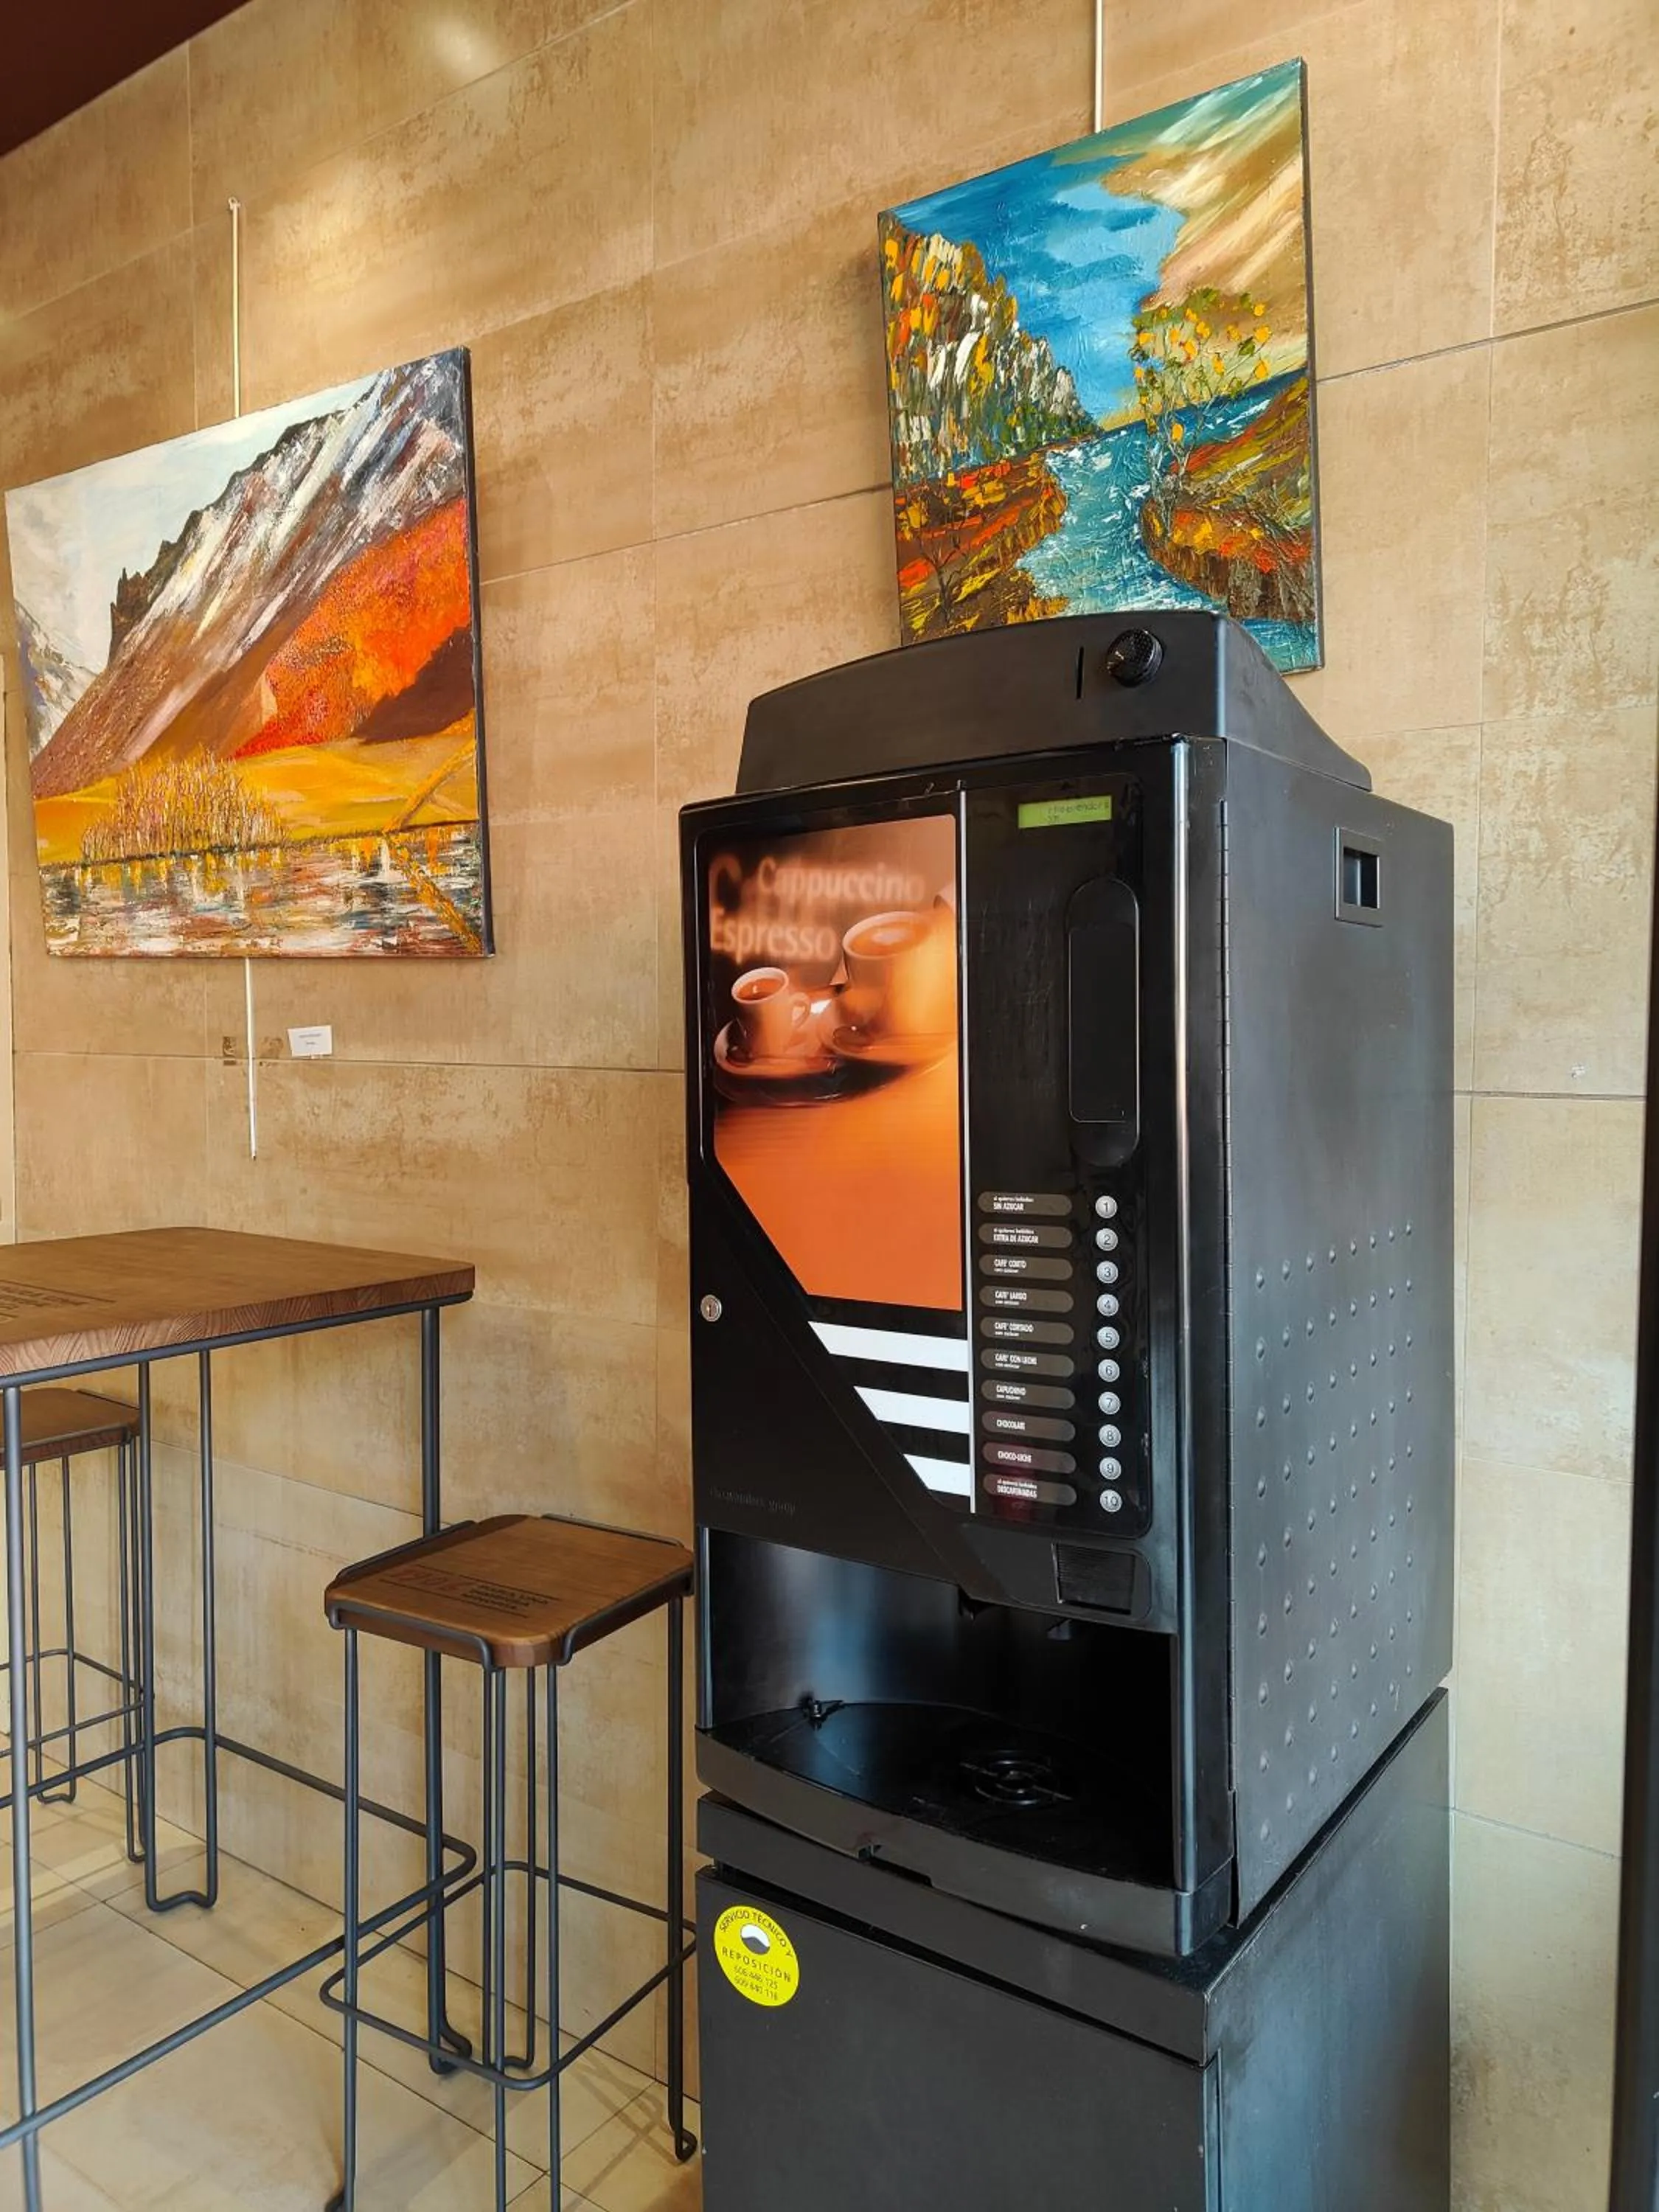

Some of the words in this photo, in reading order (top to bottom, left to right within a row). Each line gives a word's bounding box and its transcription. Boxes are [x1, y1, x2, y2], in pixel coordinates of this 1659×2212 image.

[757, 856, 925, 902] Cappuccino
[710, 905, 838, 964] Espresso
[1102, 1202, 1110, 1213] 1
[1103, 1234, 1111, 1245] 2
[1104, 1267, 1111, 1278] 3
[1104, 1299, 1111, 1310] 4
[1105, 1332, 1113, 1343] 5
[1105, 1366, 1113, 1377] 6
[1105, 1398, 1113, 1409] 7
[996, 1419, 1026, 1430] CHOCOLATE
[1107, 1430, 1114, 1441] 8
[1107, 1463, 1114, 1474] 9
[1105, 1496, 1119, 1507] 10
[720, 1910, 750, 1933] SERVICIO
